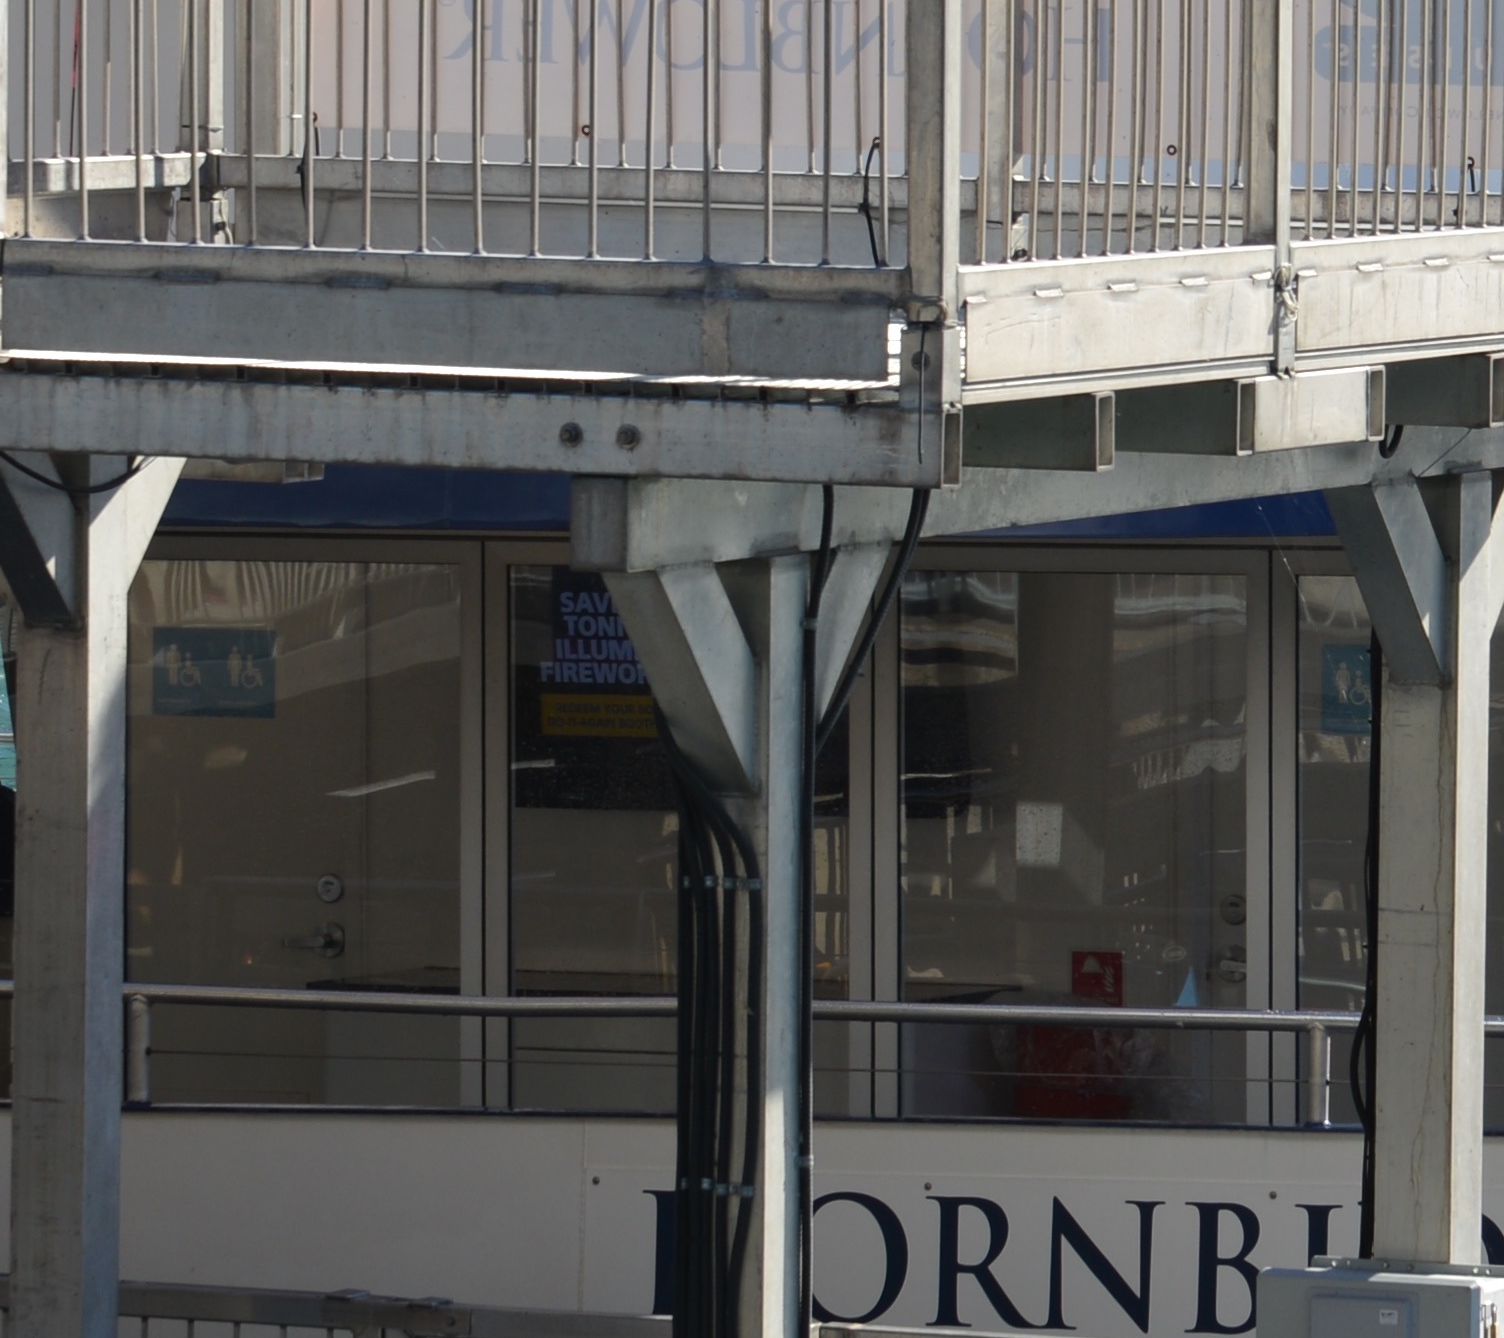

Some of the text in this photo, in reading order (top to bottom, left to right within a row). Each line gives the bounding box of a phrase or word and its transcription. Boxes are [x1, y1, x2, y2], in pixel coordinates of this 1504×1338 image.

[560, 591, 617, 614] SAV
[563, 615, 625, 637] TONI
[555, 638, 640, 661] ILLUM
